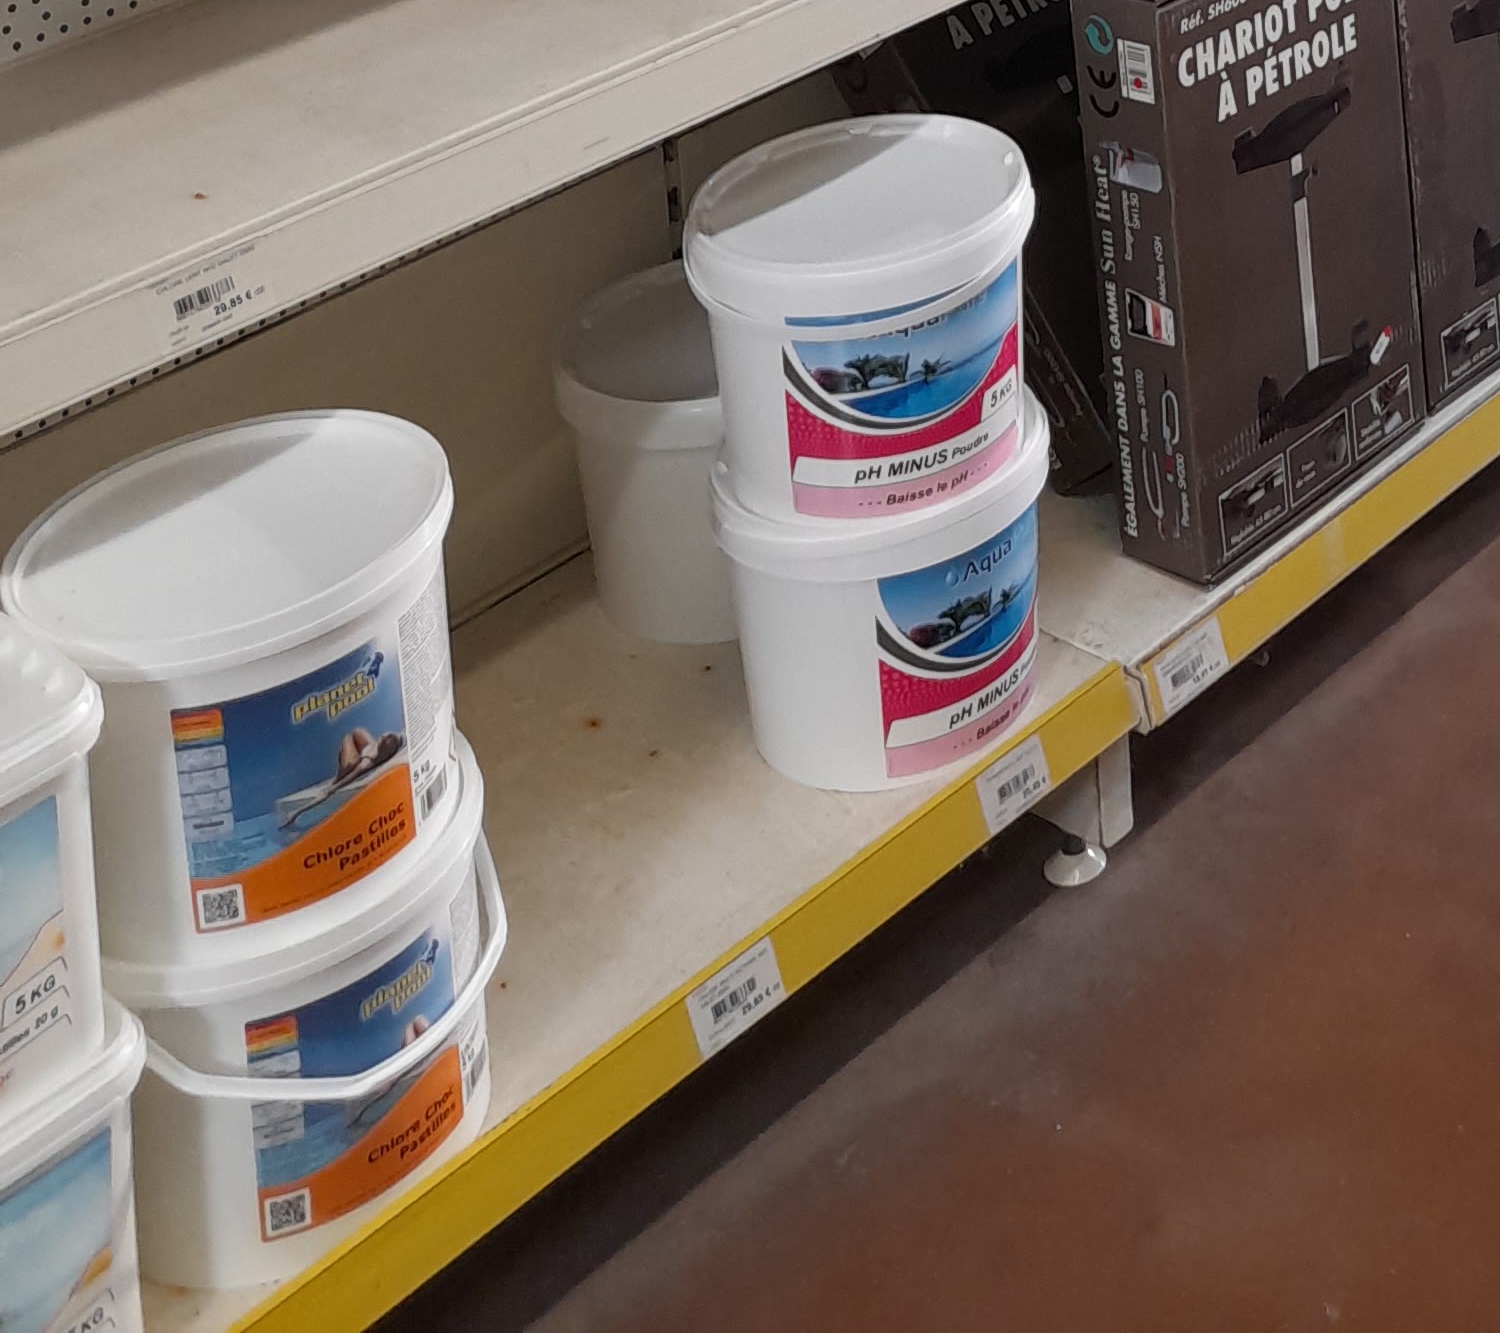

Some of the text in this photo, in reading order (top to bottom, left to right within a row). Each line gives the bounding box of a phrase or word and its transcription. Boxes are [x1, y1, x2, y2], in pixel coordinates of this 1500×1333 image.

[1180, 11, 1204, 34] Réf.
[1218, 13, 1358, 123] À PÉTROLE
[990, 378, 1013, 408] 5 KG
[1101, 227, 1138, 537] ÉGALEMENT DANS LA GAMME Sun
[854, 432, 989, 484] pH MINUS Poudre
[887, 470, 968, 506] Baisse le pH
[293, 671, 366, 723] planet
[329, 678, 376, 721] pool
[949, 668, 1020, 729] pH MINUS
[413, 770, 420, 783] 5
[303, 801, 405, 870] Chlore Choc
[339, 819, 406, 871] Pastilles
[15, 975, 57, 1014] 5 KG
[368, 1086, 454, 1164] Chlore Choc
[399, 1104, 456, 1160] Pastilles
